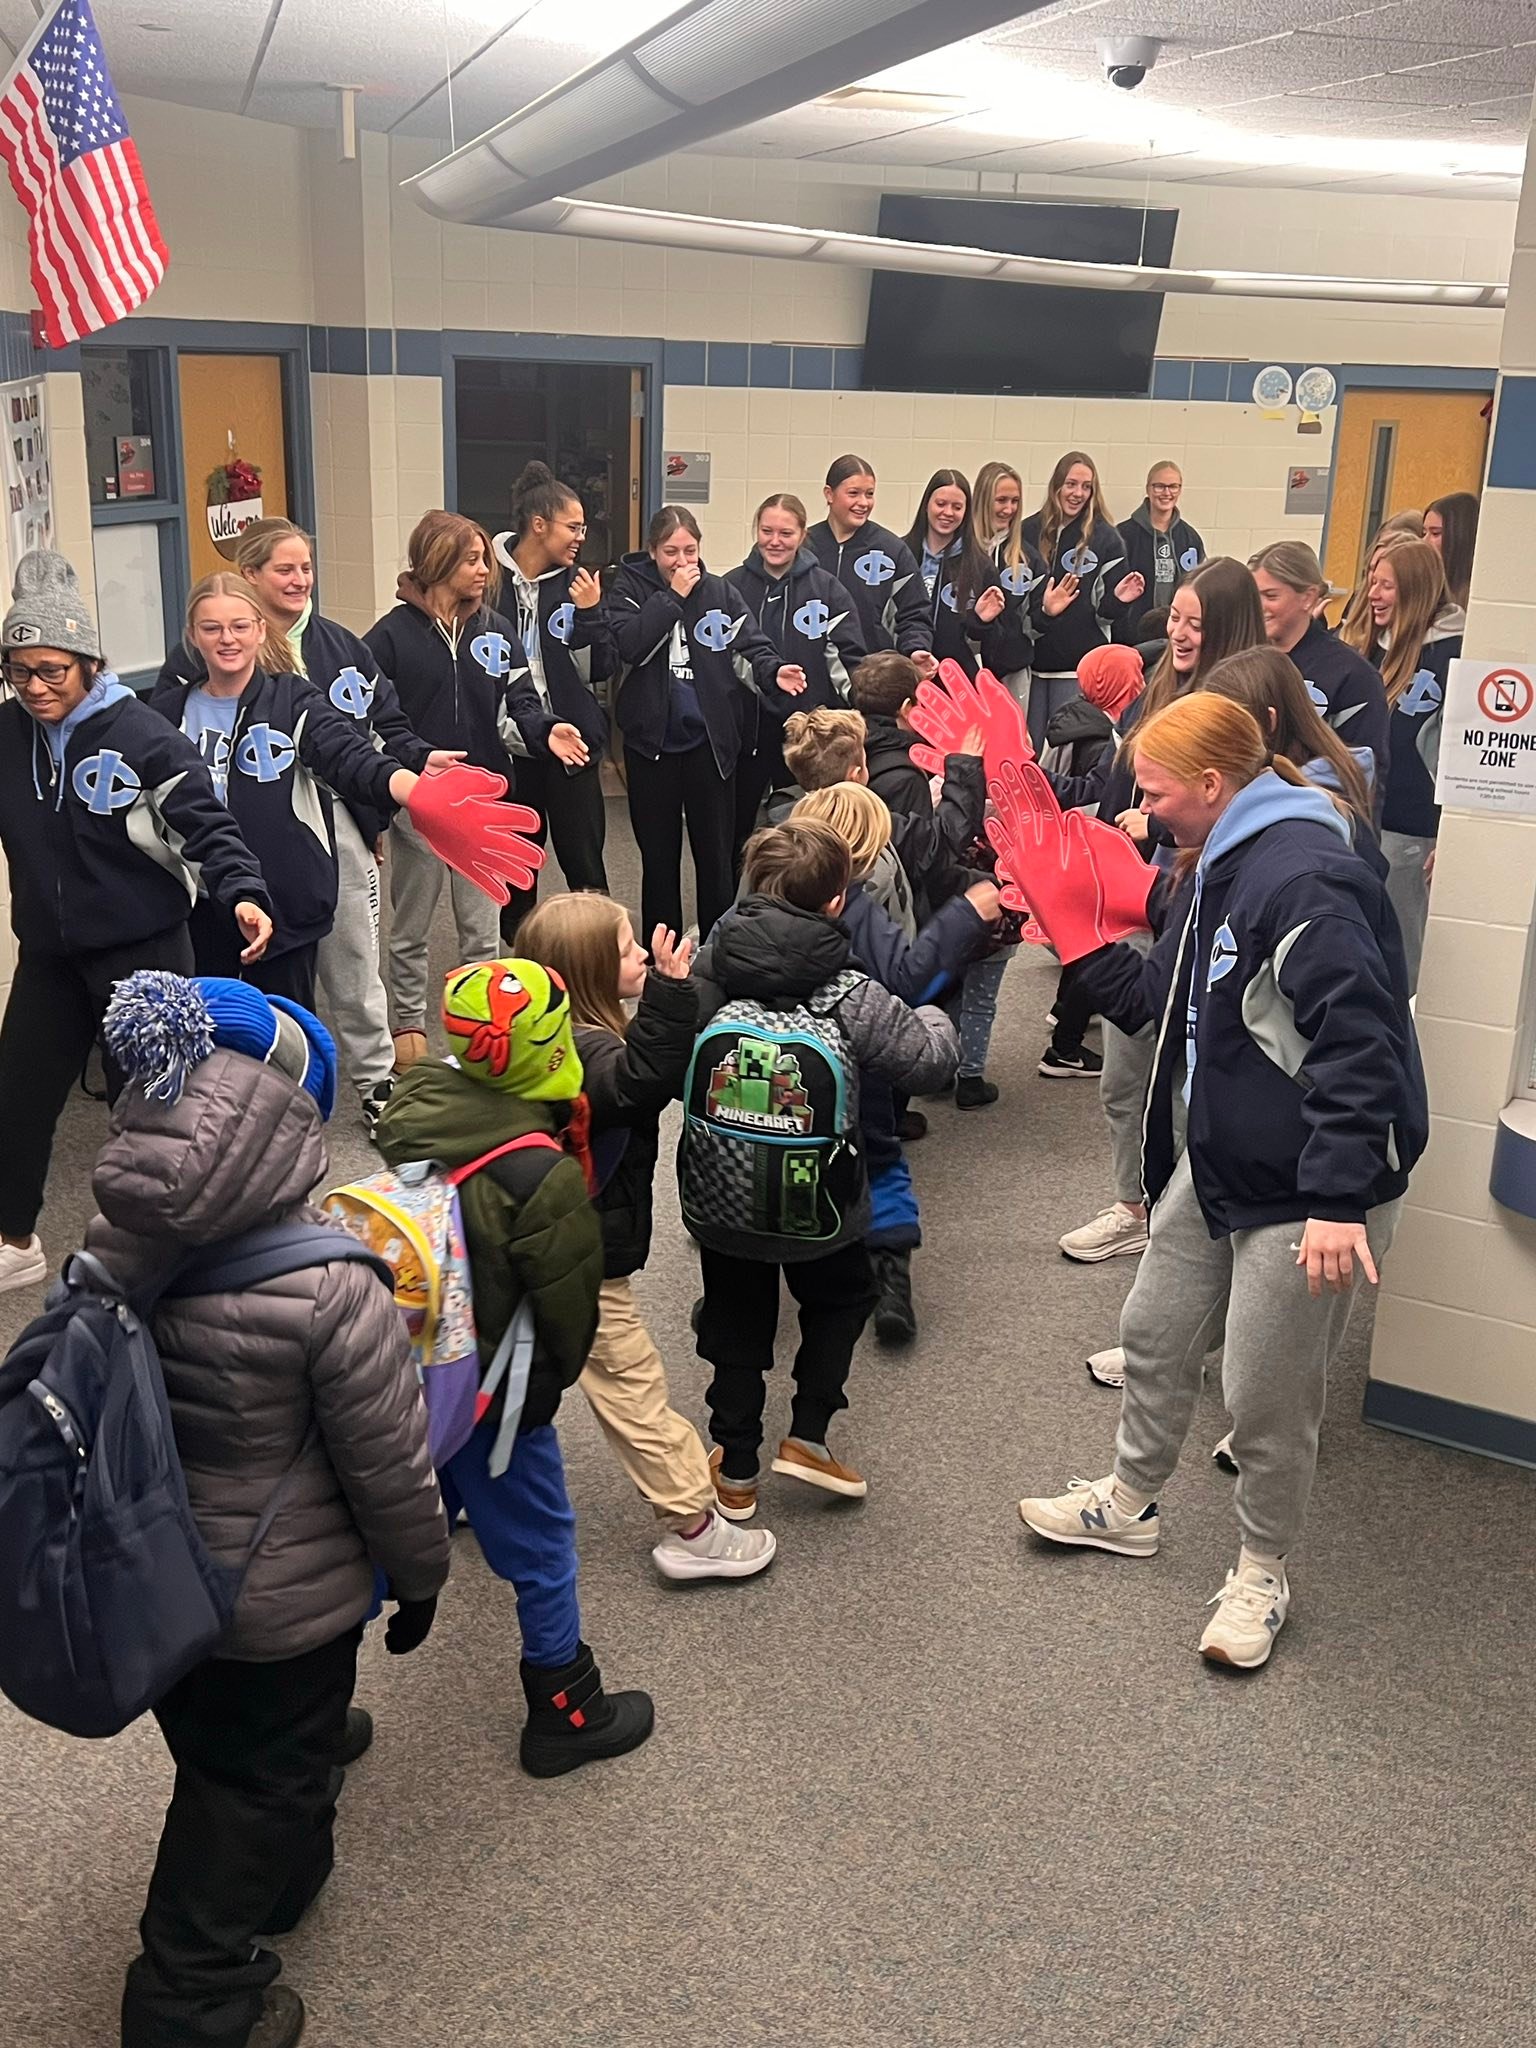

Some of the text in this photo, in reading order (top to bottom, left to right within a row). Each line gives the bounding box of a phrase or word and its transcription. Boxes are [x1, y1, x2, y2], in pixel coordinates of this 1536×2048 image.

[695, 454, 710, 462] 303
[1463, 729, 1536, 750] NO PHONE
[1480, 750, 1517, 768] ZONE
[716, 1103, 805, 1132] MINECRAFT
